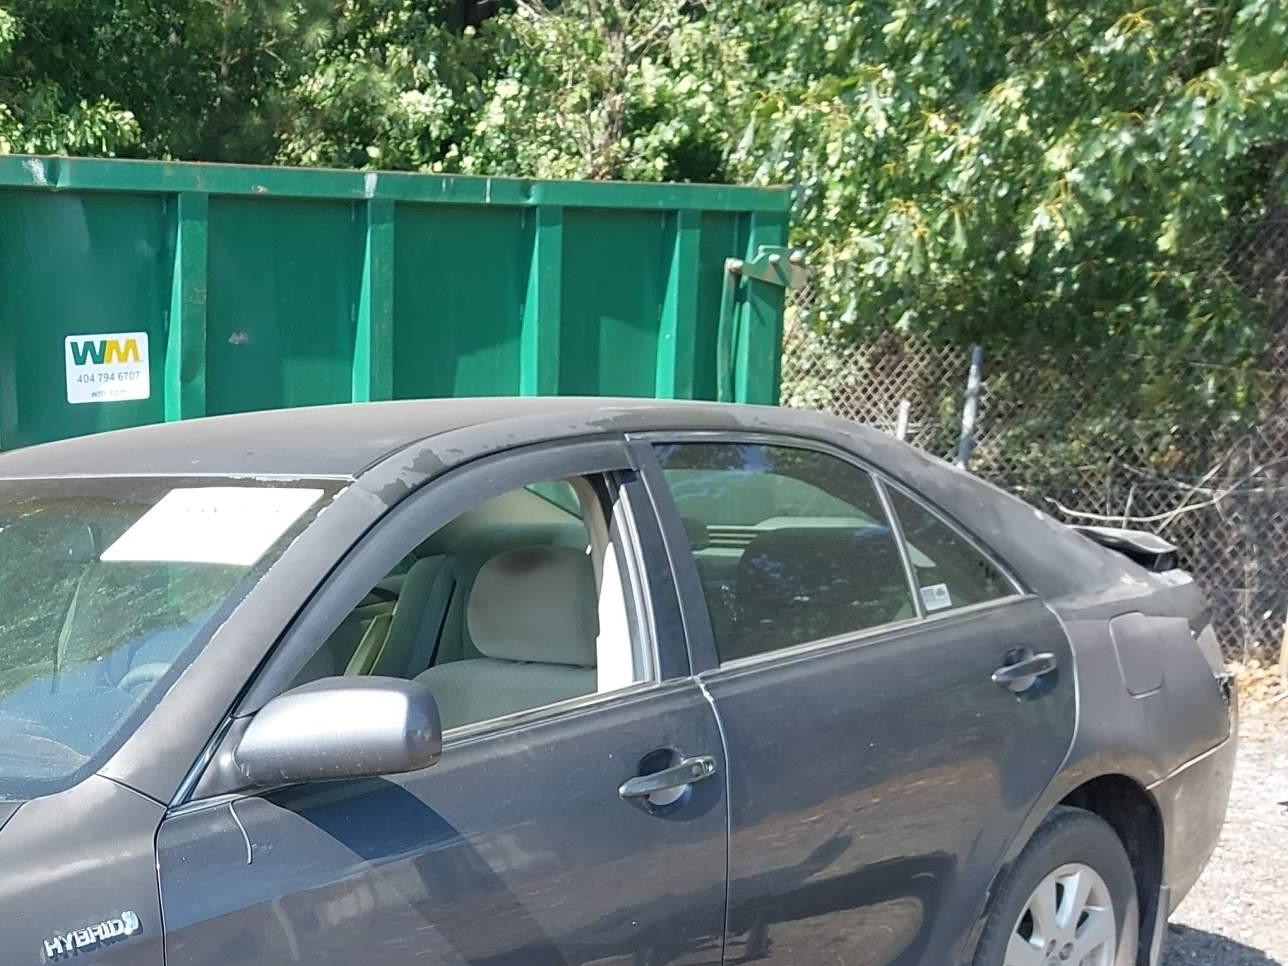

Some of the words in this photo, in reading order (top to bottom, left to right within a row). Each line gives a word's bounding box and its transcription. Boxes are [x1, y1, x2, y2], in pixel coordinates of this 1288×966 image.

[70, 339, 140, 366] WM
[76, 374, 96, 384] 404
[98, 372, 115, 382] 794
[118, 371, 140, 381] 6707
[43, 919, 124, 957] HYBRID
